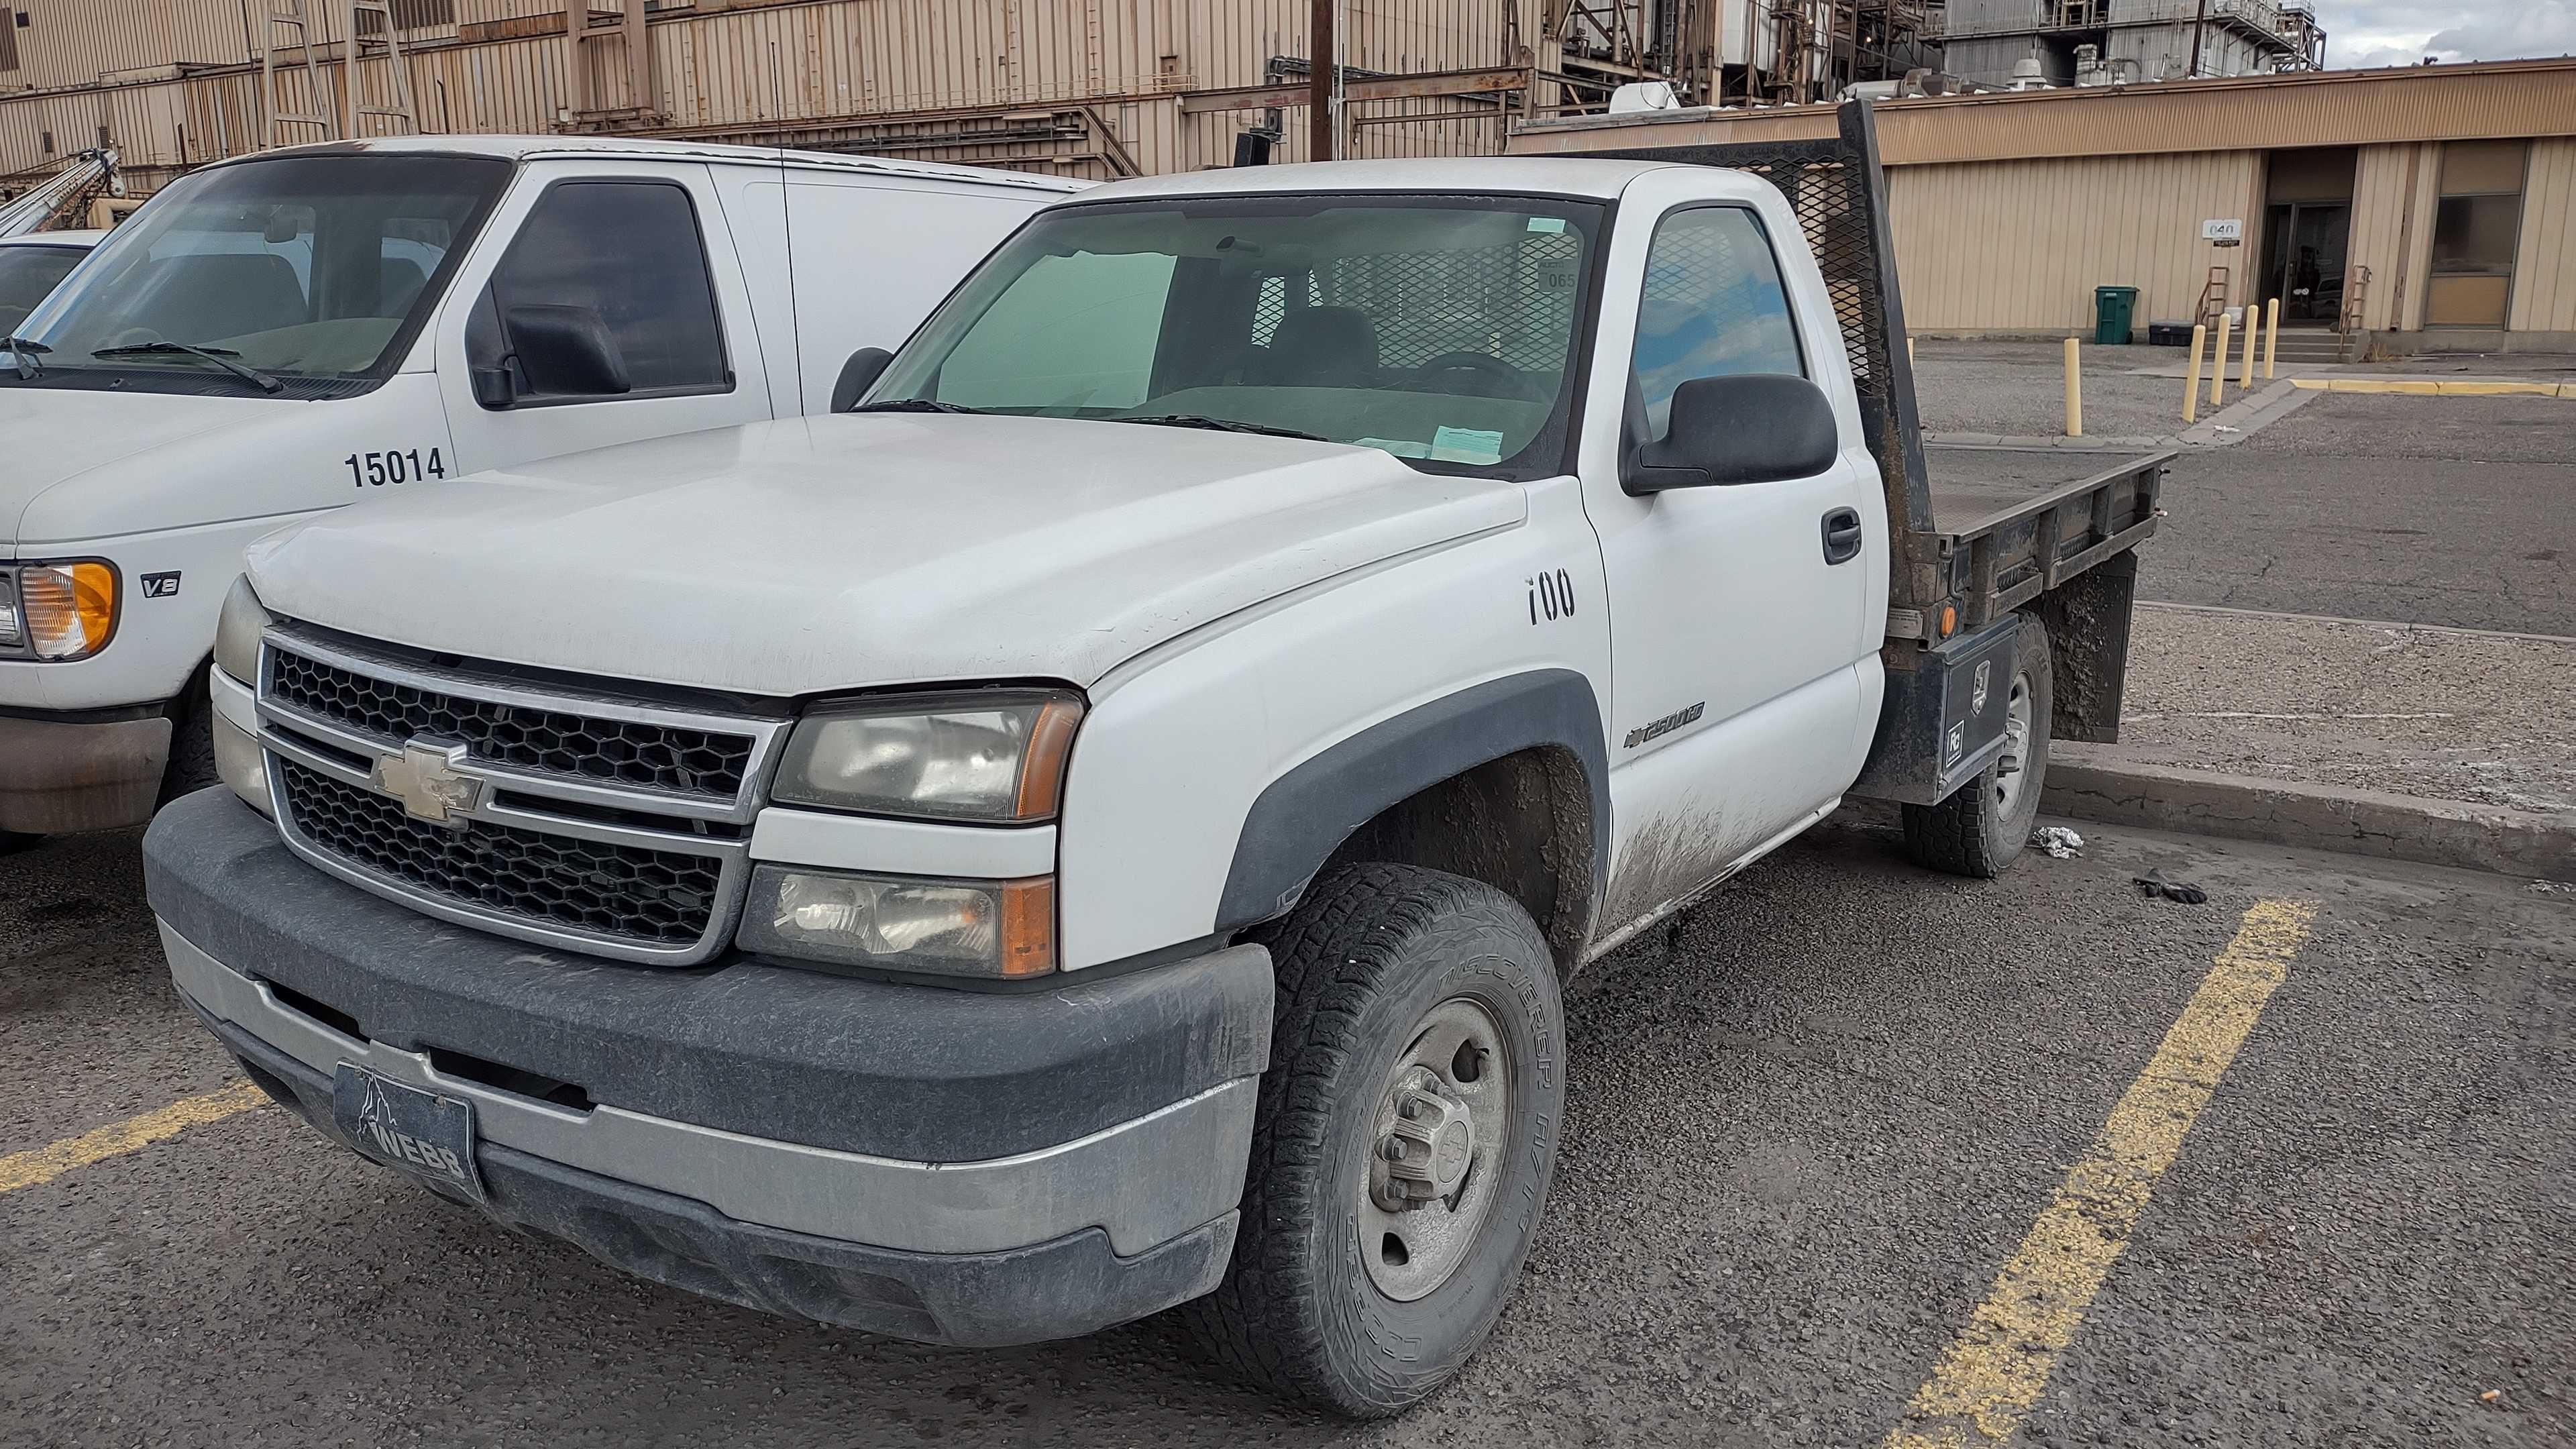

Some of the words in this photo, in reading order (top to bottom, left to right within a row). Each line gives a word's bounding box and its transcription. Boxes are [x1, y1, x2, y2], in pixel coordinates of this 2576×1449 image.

[1549, 273, 1576, 288] 065
[345, 447, 445, 488] 15014
[143, 578, 178, 597] V8
[1432, 953, 1552, 1090] DISCOVERER
[368, 1121, 466, 1180] WEBB
